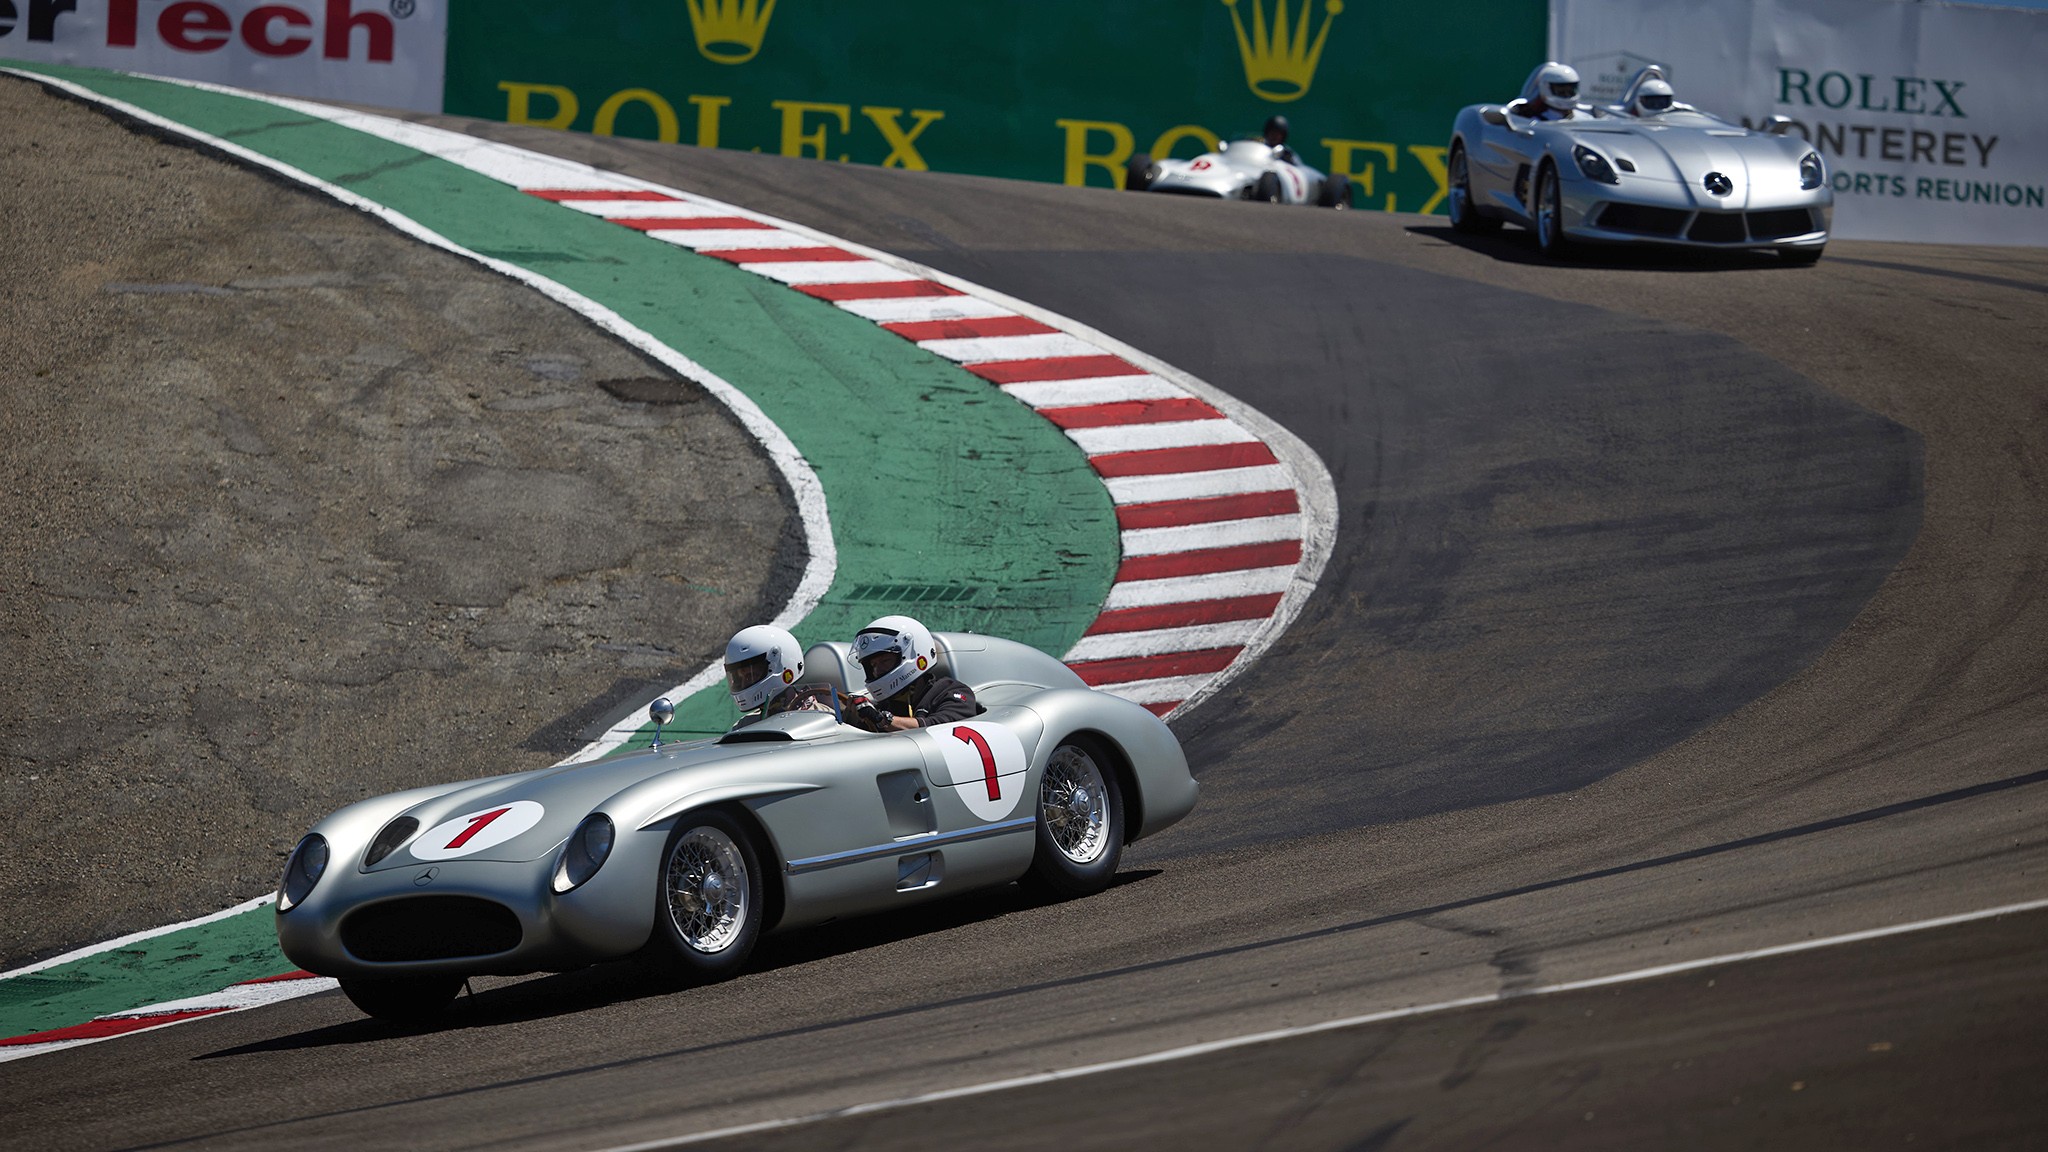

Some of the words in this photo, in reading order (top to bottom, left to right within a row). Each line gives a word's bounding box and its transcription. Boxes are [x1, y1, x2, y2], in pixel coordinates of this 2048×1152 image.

[1777, 67, 1968, 118] ROLEX
[1917, 178, 2046, 209] REUNION
[953, 726, 1002, 801] 1
[443, 807, 512, 850] 1
